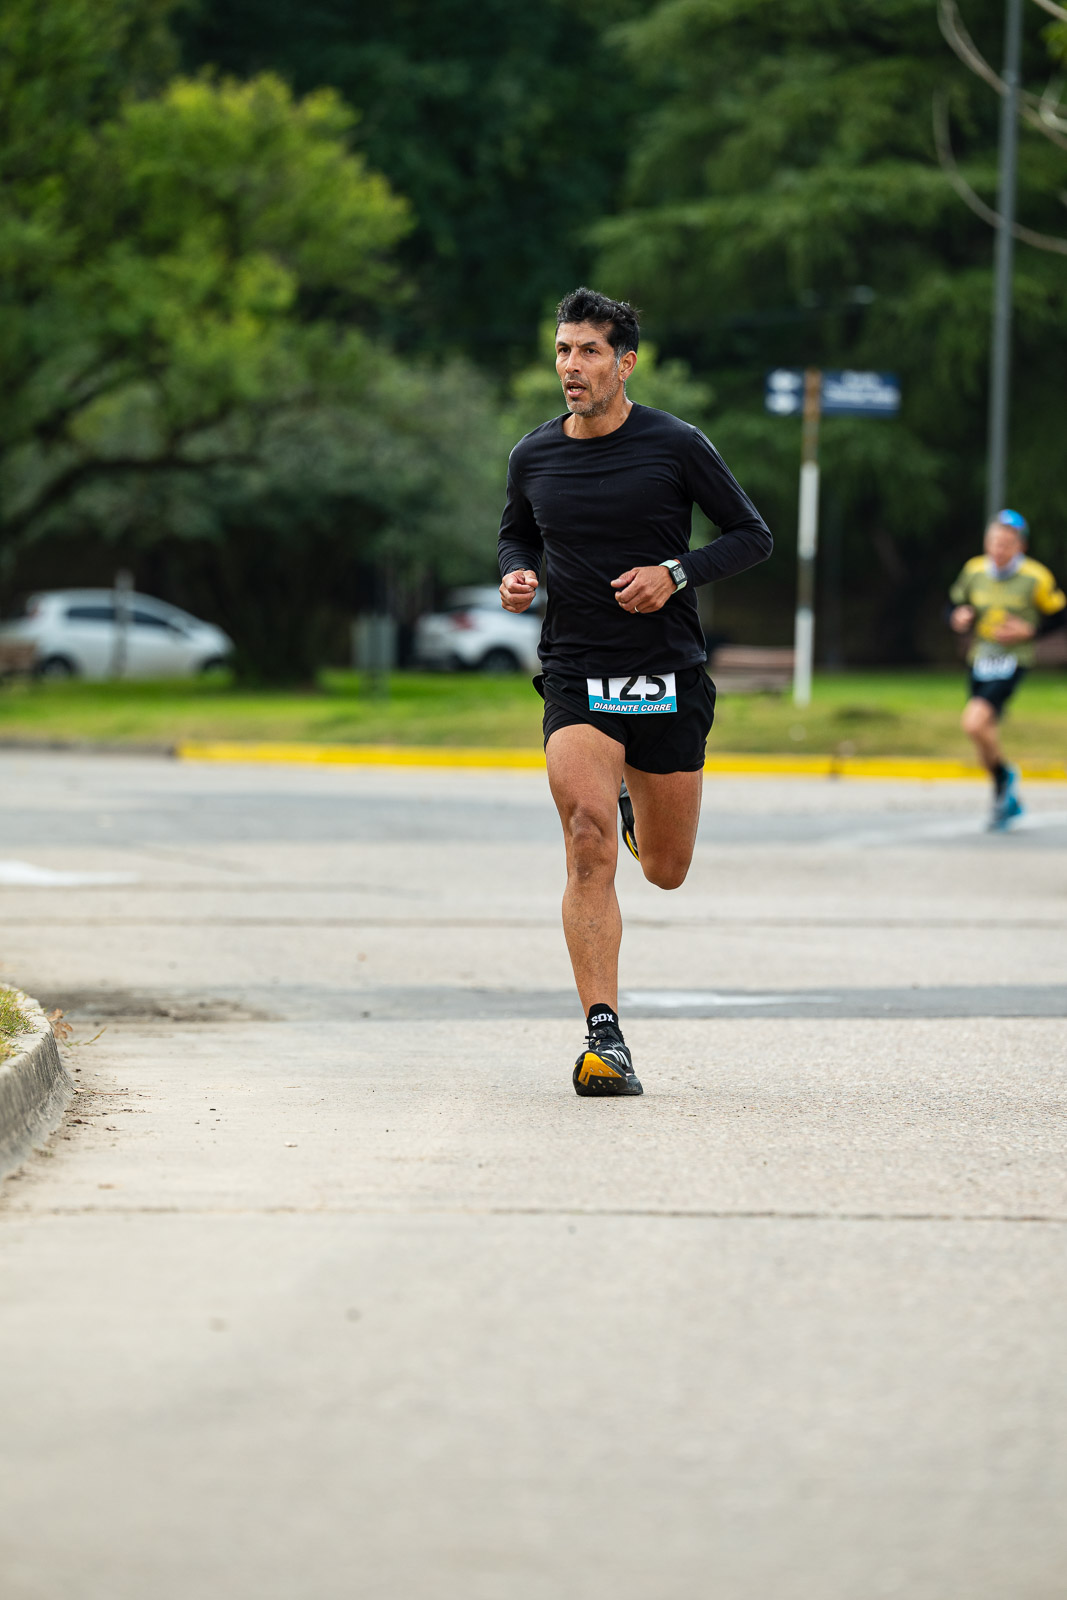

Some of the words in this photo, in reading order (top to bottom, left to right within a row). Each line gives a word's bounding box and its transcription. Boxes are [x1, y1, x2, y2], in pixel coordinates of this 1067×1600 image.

[602, 675, 666, 701] 125
[593, 702, 639, 711] DIAMANTE
[641, 703, 672, 711] CORRE
[591, 1013, 614, 1026] SOX
